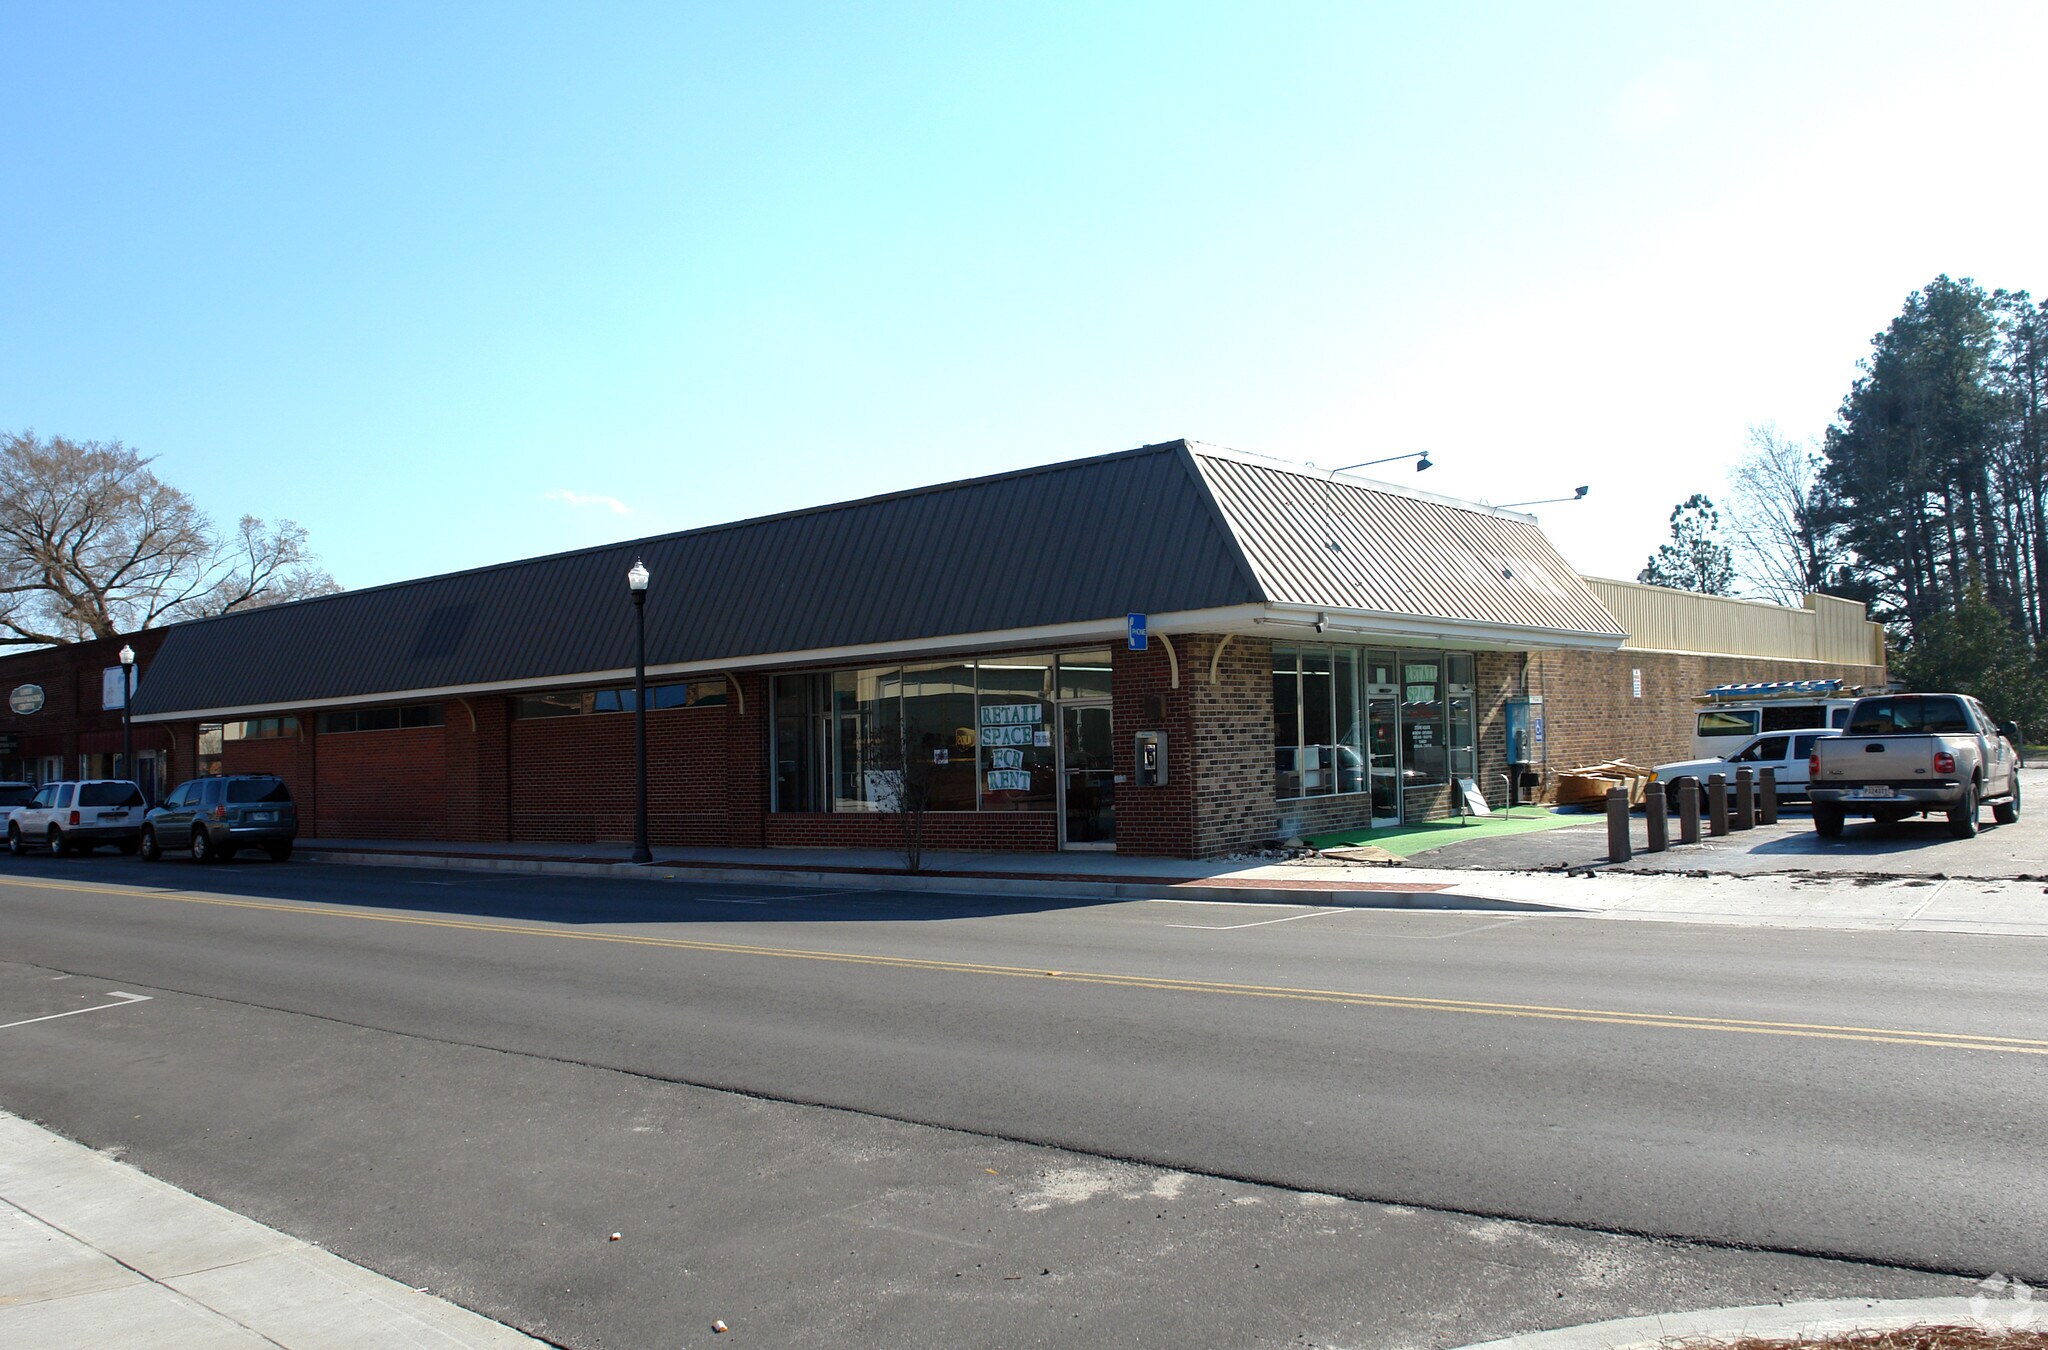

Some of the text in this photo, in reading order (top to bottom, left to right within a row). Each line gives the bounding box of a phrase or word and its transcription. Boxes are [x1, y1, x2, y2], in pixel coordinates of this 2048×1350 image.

[982, 706, 1041, 724] RETAIL
[983, 727, 1031, 745] SPACE
[988, 772, 1030, 789] RENT
